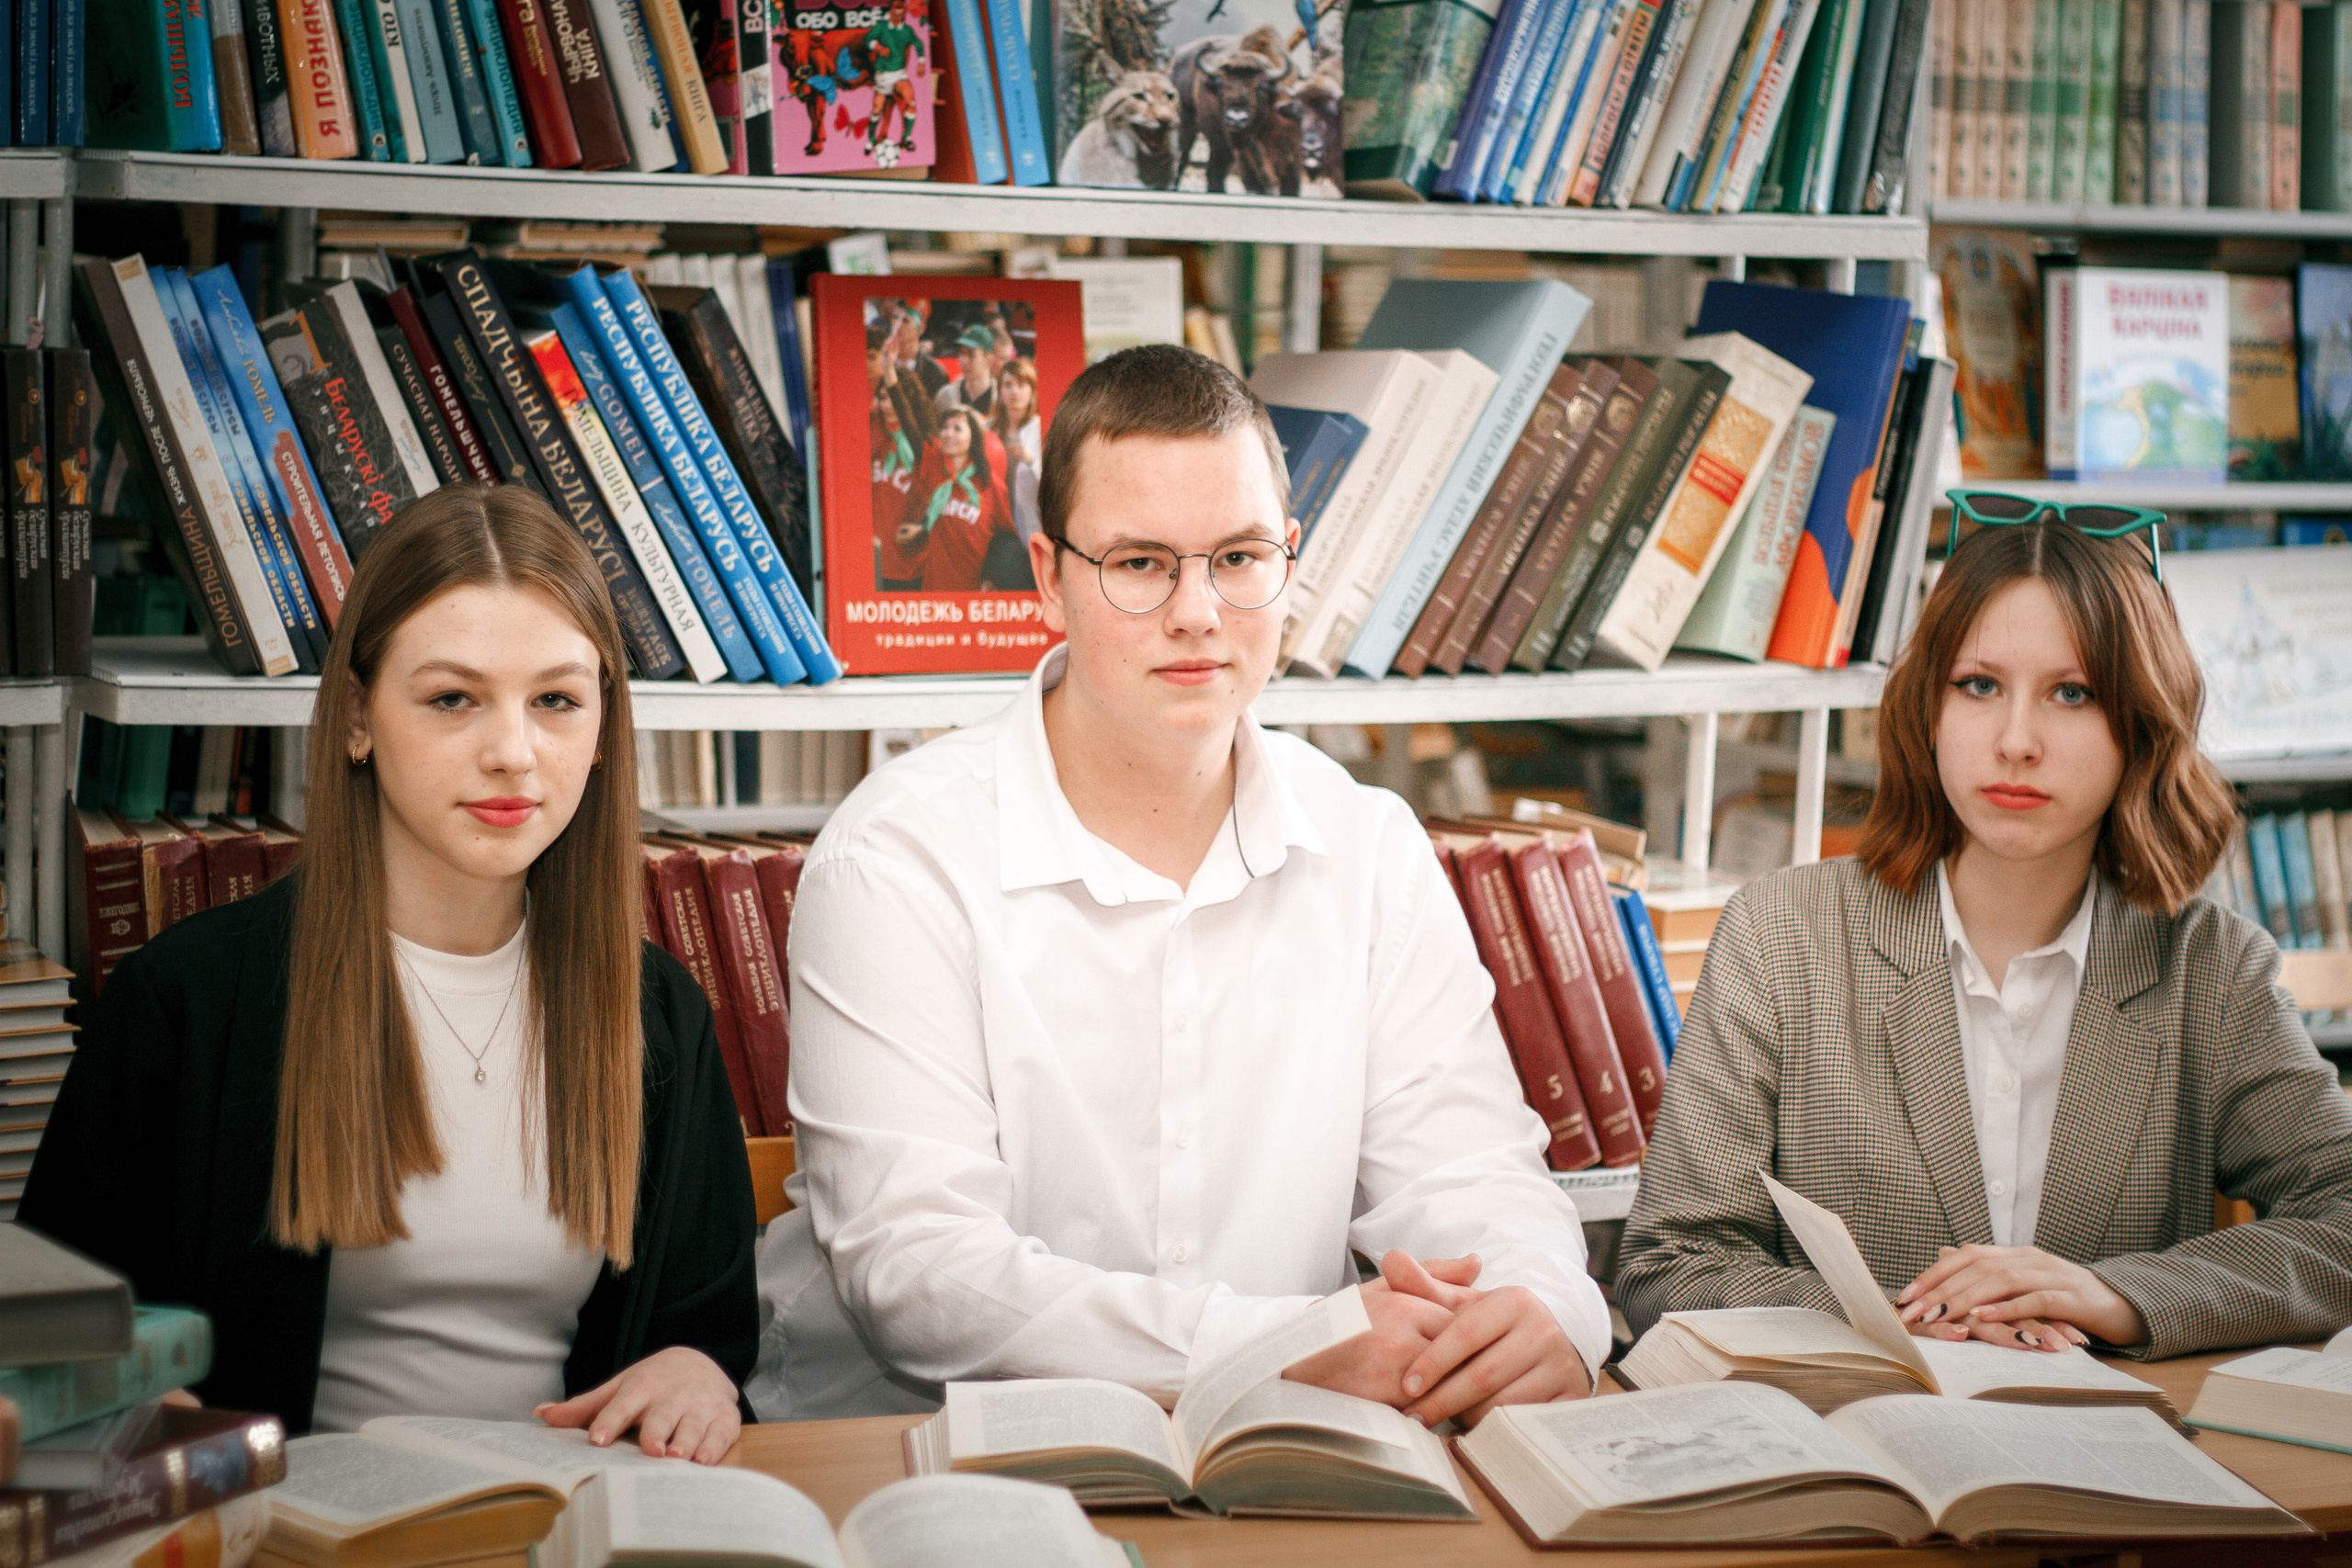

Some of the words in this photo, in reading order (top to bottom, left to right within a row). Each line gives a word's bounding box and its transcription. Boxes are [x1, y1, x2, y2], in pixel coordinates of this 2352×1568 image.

[163, 0, 192, 108] БОЛЬШАЯ
[380, 10, 400, 48] КТО
[548, 0, 586, 84] ЧЫРВОНА
[572, 27, 601, 80] КНІГА
[795, 10, 838, 29] ОБО
[480, 6, 526, 135] ЭНЦИКЛОПЕДИЯ
[318, 118, 340, 137] Я
[124, 355, 157, 422] ЧЕРНОБЫЛЯ
[241, 358, 278, 425] ГОМЕЛЬ
[387, 343, 437, 424] СУЧАСНАЕ
[449, 262, 557, 445] СПАДЧЫНА
[539, 437, 628, 585] БЕЛАРУСІ
[1462, 331, 1561, 494] ГЕОГРАФИЧЕСКИЙ
[149, 423, 173, 463] ПОСЛЕ
[591, 294, 680, 453] РЕСПУБЛИКА
[669, 449, 743, 573] БЕЛАРУСЬ
[594, 381, 650, 467] GOMEL
[623, 297, 715, 457] РЕСПУБЛИКА
[703, 452, 779, 577] БЕЛАРУСЬ
[163, 462, 188, 505] ЖИЗНЬ
[189, 373, 221, 434] РЕСУРСЫ
[231, 479, 273, 565] ГОМЕЛЬСКОЙ
[264, 569, 297, 629] ОБЛАСТИ
[210, 374, 243, 436] РЕСУРСЫ
[251, 482, 293, 567] ГОМЕЛЬСКОЙ
[285, 570, 317, 631] ОБЛАСТИ
[561, 387, 635, 514] ГОМЕЛЬЩИНА
[629, 520, 695, 633] КУЛЬТУРНАЯ
[277, 450, 326, 542] СТРОИТЕЛЬНАЯ
[314, 540, 350, 604] ЛЕТОПИСЬ
[176, 502, 244, 647] ГОМЕЛЬЩИНА
[683, 552, 740, 640] ГОМЕЛЬ
[741, 575, 761, 604] ГОДЫ
[845, 600, 964, 626] МОЛОДЕЖЬ
[625, 584, 673, 666] HERITAGE
[776, 577, 796, 604] ГОДЫ
[789, 601, 822, 656] СОЗИДАНИЯ
[876, 631, 955, 648] традиции
[959, 634, 971, 646] и
[976, 628, 1048, 649] будущее
[670, 889, 695, 956] СОВЕТСКАЯ
[682, 886, 722, 1010] ЭНЦИКЛОПЕДИЯ
[728, 892, 756, 958] СОВЕТСКАЯ
[738, 887, 785, 1011] ЭНЦИКЛОПЕДИЯ
[745, 961, 768, 1014] БОЛЬШАЯ
[1547, 1074, 1564, 1100] 5
[1600, 1070, 1614, 1094] 4
[1637, 1066, 1657, 1092] 3
